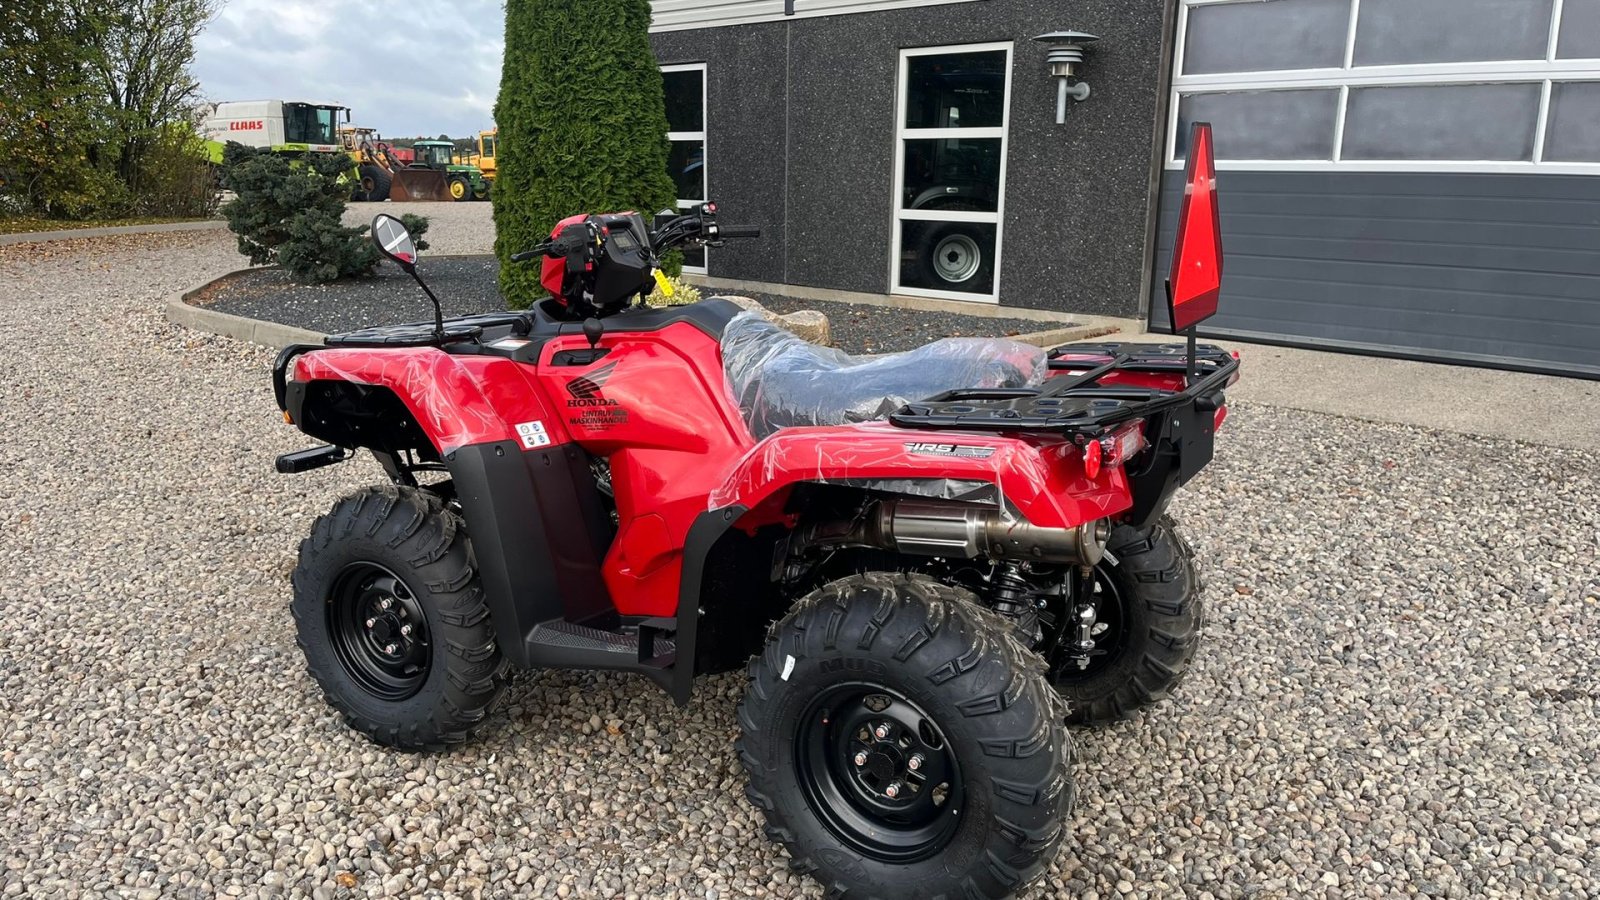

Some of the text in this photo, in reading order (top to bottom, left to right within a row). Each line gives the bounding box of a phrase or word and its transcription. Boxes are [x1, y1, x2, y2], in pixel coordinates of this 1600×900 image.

[230, 121, 263, 130] CLAAS
[567, 399, 619, 407] HONDA
[913, 442, 954, 452] IRS
[820, 658, 887, 675] MUD
